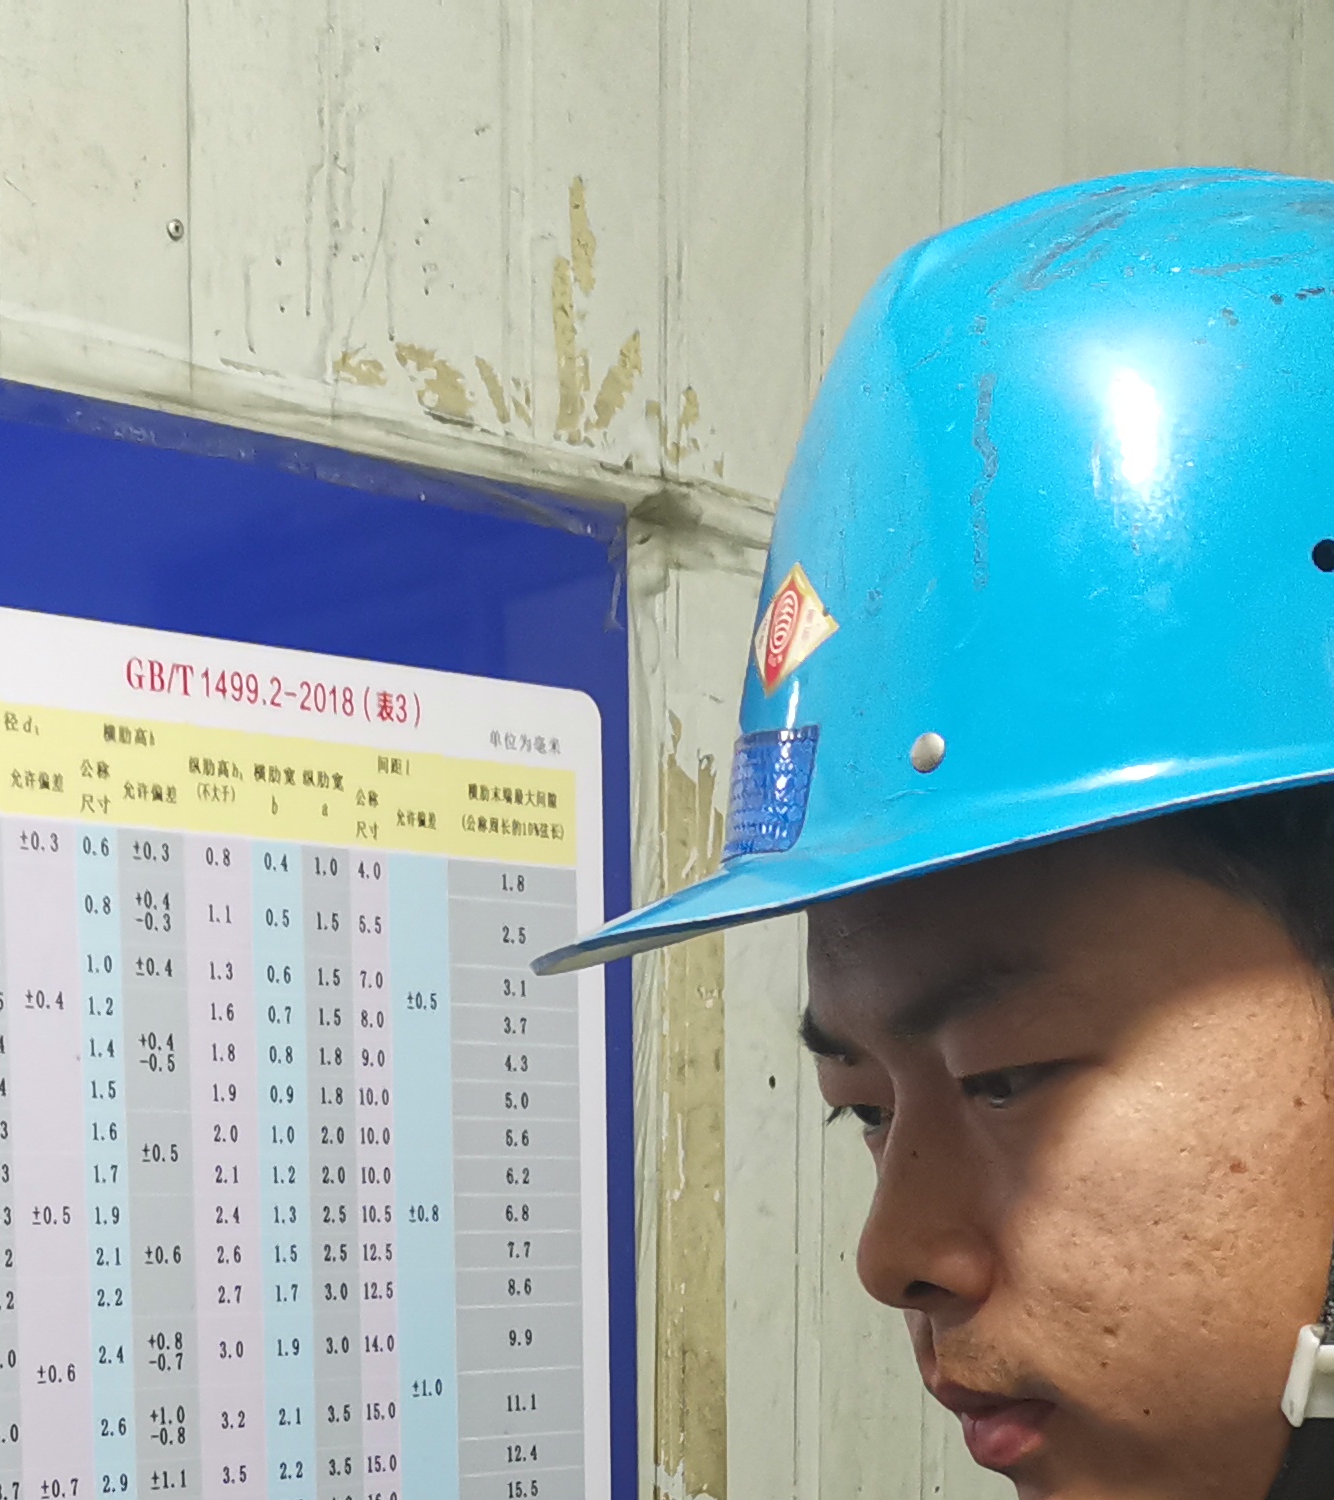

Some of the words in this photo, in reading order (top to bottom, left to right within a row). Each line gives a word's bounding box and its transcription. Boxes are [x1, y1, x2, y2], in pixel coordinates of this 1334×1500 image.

[10, 768, 64, 793] 允许偏差
[19, 830, 59, 853] ±0.3
[24, 989, 65, 1011] ±0.4
[503, 1016, 528, 1035] 3.7
[504, 1054, 529, 1073] 4.3
[504, 1091, 530, 1110] 5.0
[505, 1167, 530, 1185] 6.2
[32, 1205, 71, 1226] ±0.5
[505, 1203, 530, 1223] 6.8
[506, 1240, 531, 1259] 7.7
[507, 1277, 532, 1297] 8.6
[508, 1328, 533, 1347] 9.9
[36, 1363, 76, 1385] ±0.6
[40, 1477, 79, 1500] ±0.7
